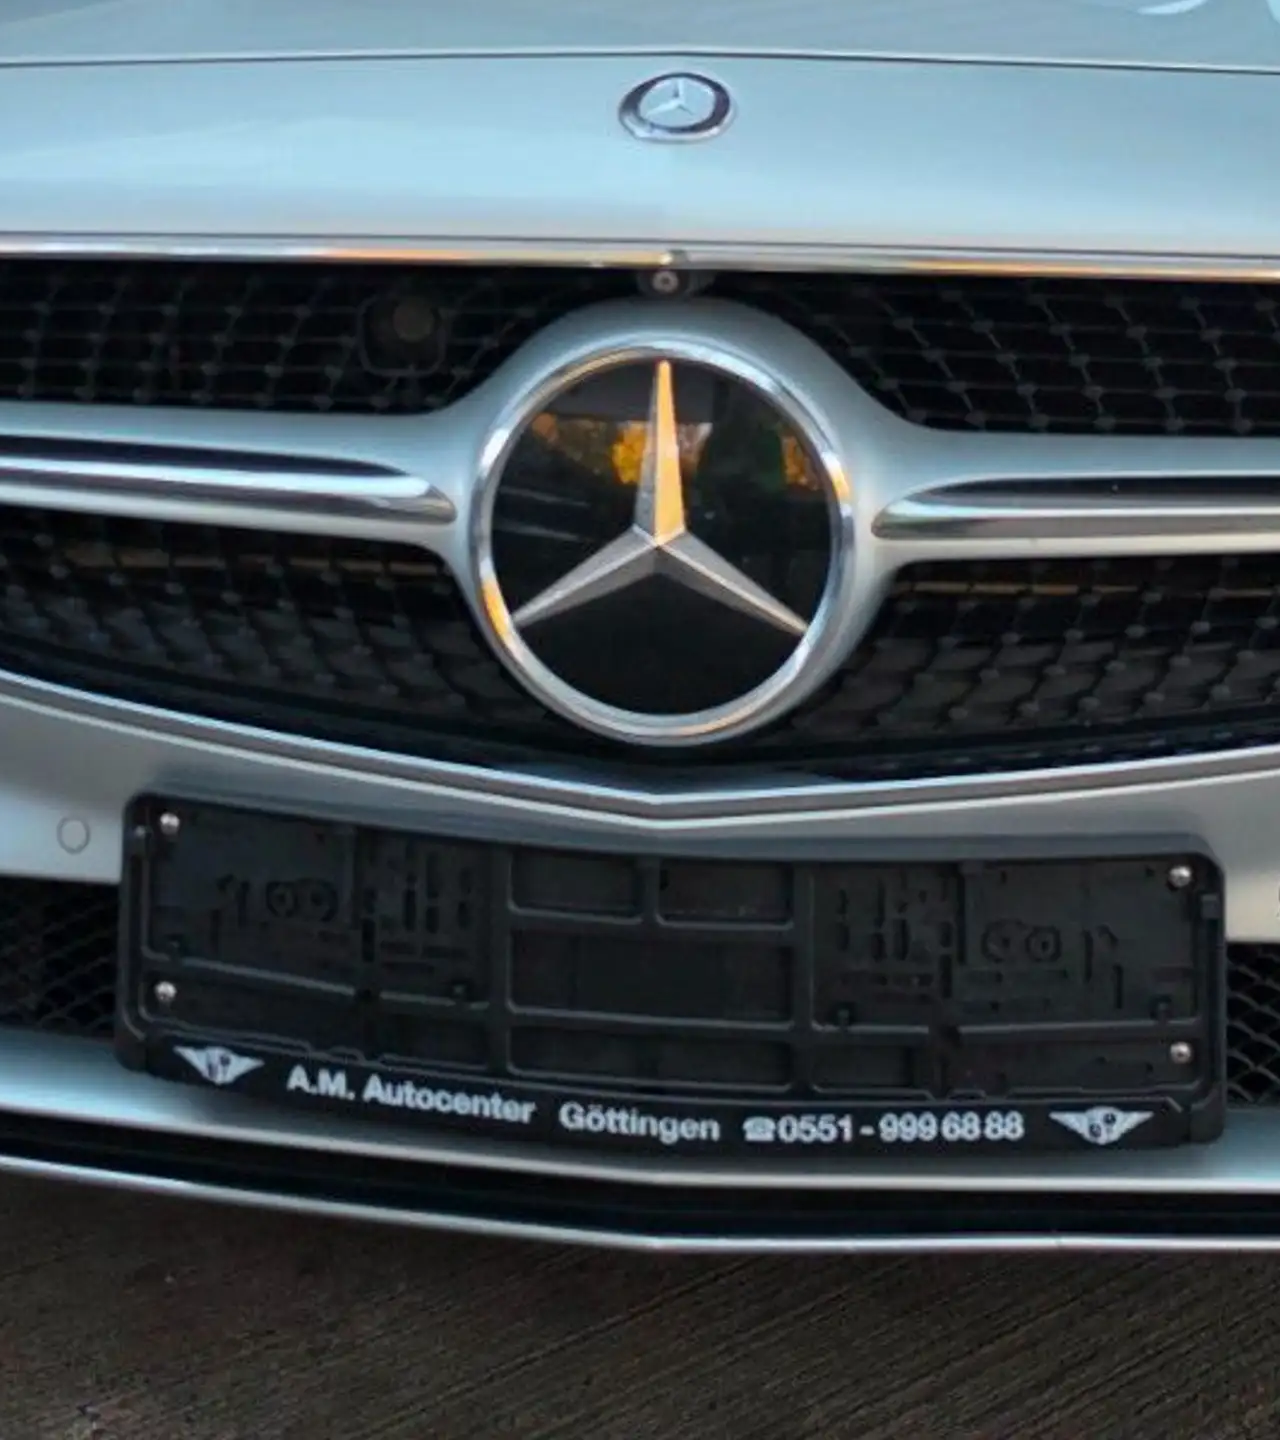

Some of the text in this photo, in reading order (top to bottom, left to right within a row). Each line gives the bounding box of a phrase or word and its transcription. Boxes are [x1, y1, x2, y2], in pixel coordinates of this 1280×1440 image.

[286, 1064, 356, 1101] A.M.
[363, 1073, 537, 1124] Autocenter
[558, 1100, 721, 1145] Göttingen
